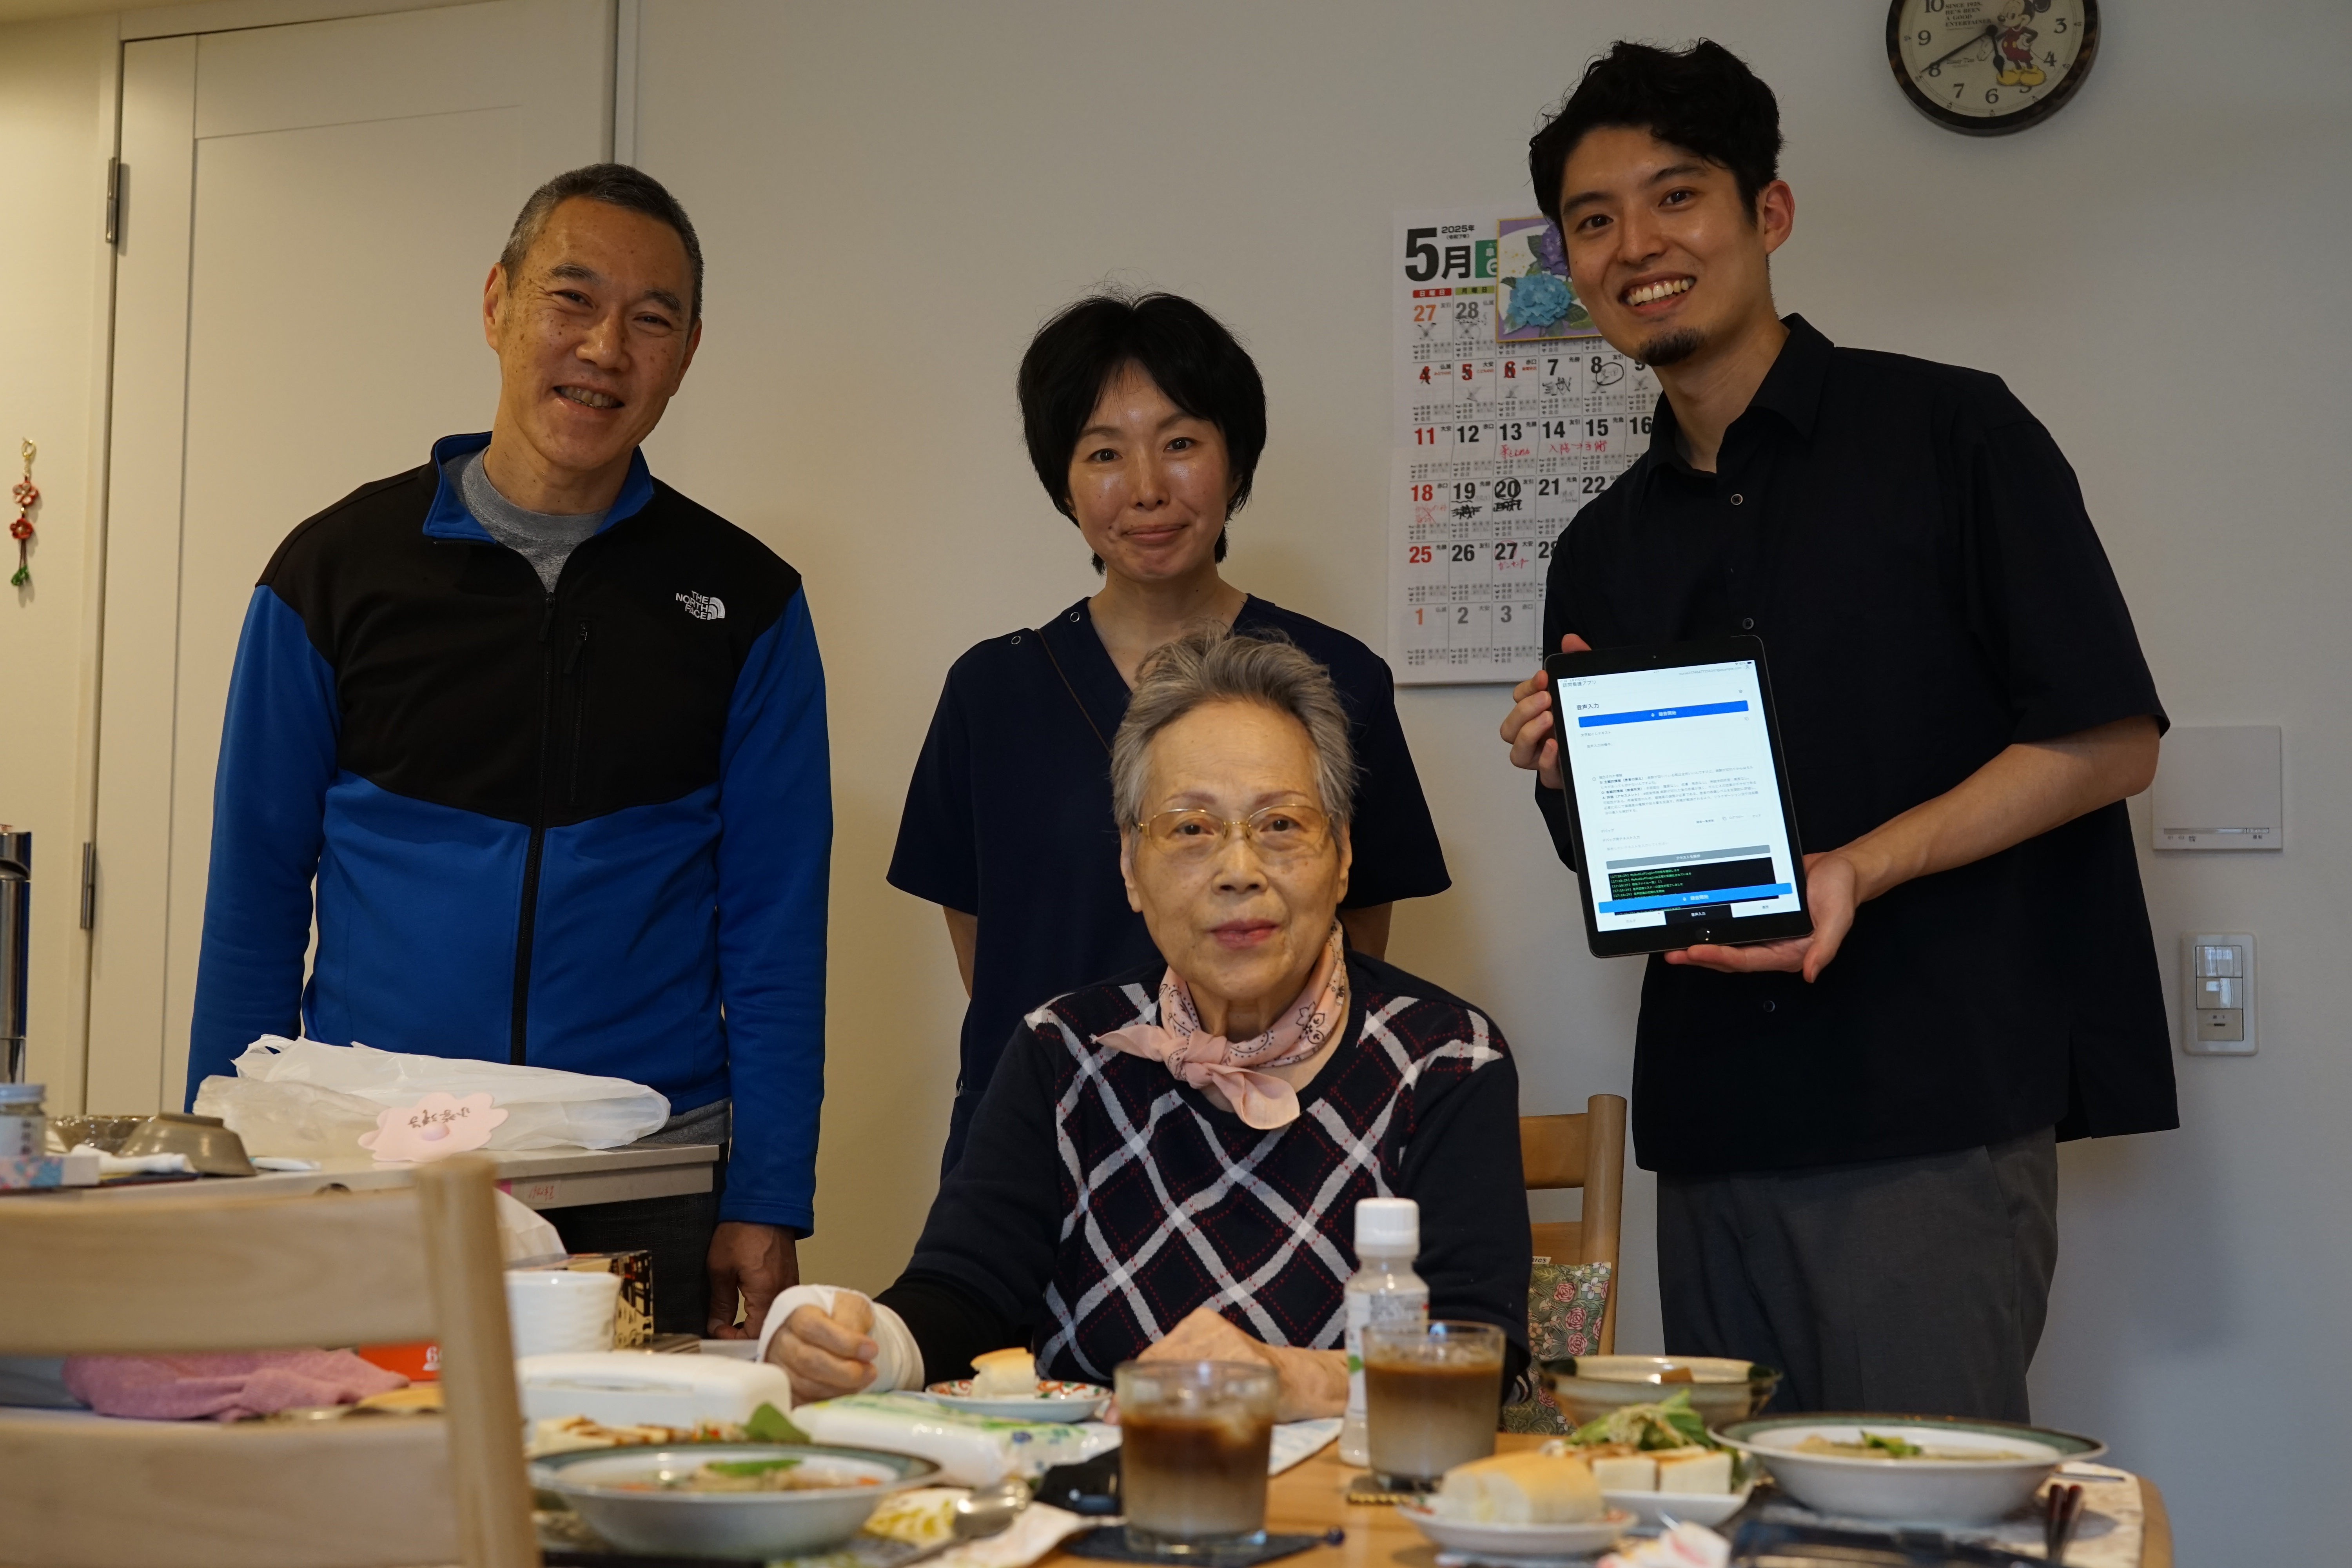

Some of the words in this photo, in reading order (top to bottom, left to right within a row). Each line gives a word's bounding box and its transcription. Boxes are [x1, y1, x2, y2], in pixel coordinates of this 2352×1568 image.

[1924, 0, 1944, 13] 10
[2054, 18, 2067, 34] 3
[1918, 29, 1931, 46] 9
[2043, 51, 2057, 67] 4
[1928, 62, 1941, 77] 8
[1953, 83, 1965, 99] 7
[1985, 88, 1999, 104] 6
[1441, 225, 1475, 234] 2025年
[1405, 227, 1470, 281] 5月
[1414, 304, 1436, 321] 27
[1455, 301, 1479, 319] 28
[1419, 366, 1431, 380] 4
[1462, 363, 1473, 380] 5
[1504, 361, 1516, 378] 6
[1548, 358, 1559, 376] 7
[1591, 356, 1602, 373] 8
[1499, 423, 1522, 441] 13
[1543, 421, 1565, 438] 14
[1586, 418, 1609, 436] 15
[1630, 416, 1652, 434] 16
[1415, 427, 1434, 445] 11
[1457, 425, 1479, 443] 12
[1411, 484, 1433, 501] 18
[1453, 482, 1475, 499] 19
[1495, 481, 1520, 498] 20
[1539, 478, 1559, 496] 21
[1582, 476, 1606, 494] 22
[1409, 546, 1432, 563] 25
[1452, 544, 1475, 561] 26
[1495, 543, 1518, 560] 27
[675, 593, 708, 612] NORTH
[691, 590, 709, 604] THE
[685, 604, 707, 620] FACE
[1416, 608, 1423, 625] 1
[1457, 606, 1469, 624] 2
[1501, 605, 1512, 622] 3
